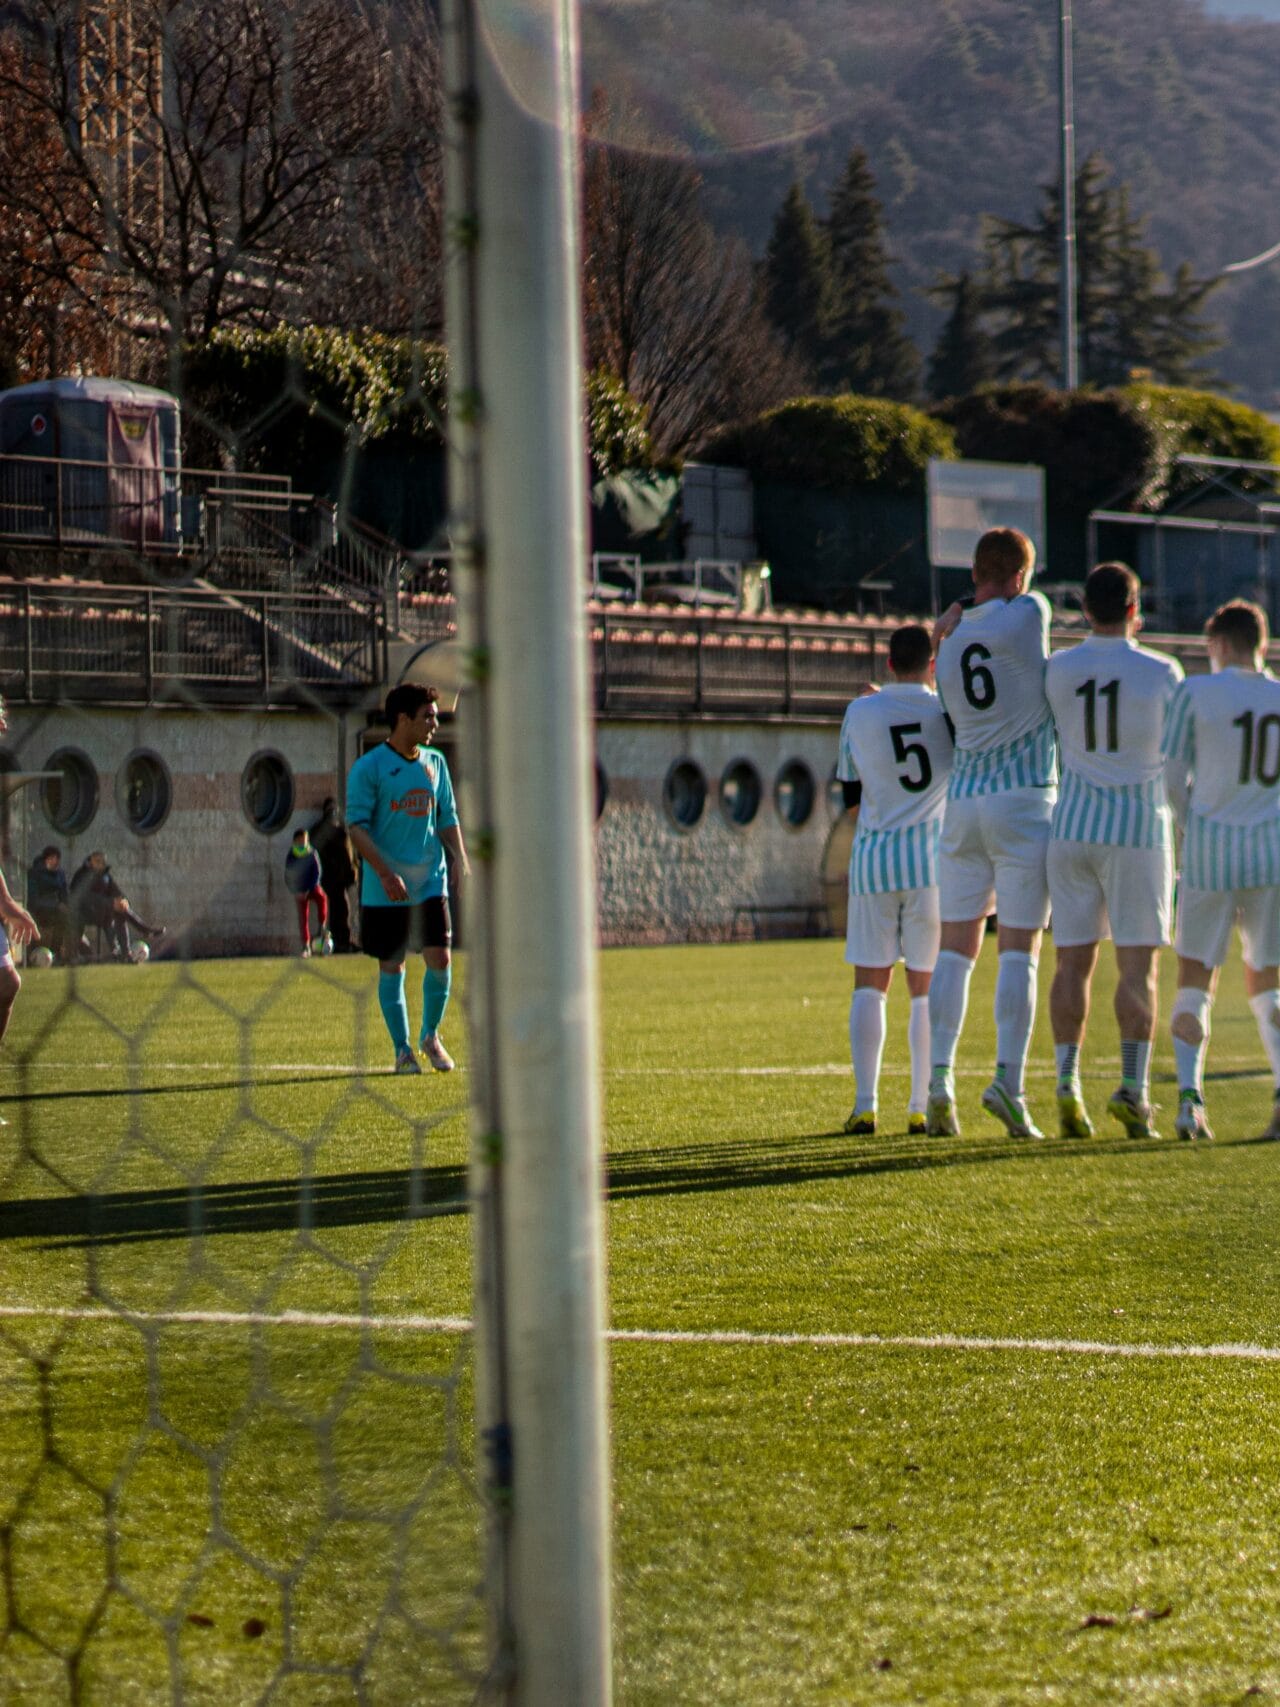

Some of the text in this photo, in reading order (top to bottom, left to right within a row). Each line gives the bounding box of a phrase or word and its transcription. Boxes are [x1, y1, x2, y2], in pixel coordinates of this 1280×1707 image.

[960, 643, 997, 711] 6
[1075, 679, 1121, 753] 11
[889, 723, 933, 793] 5
